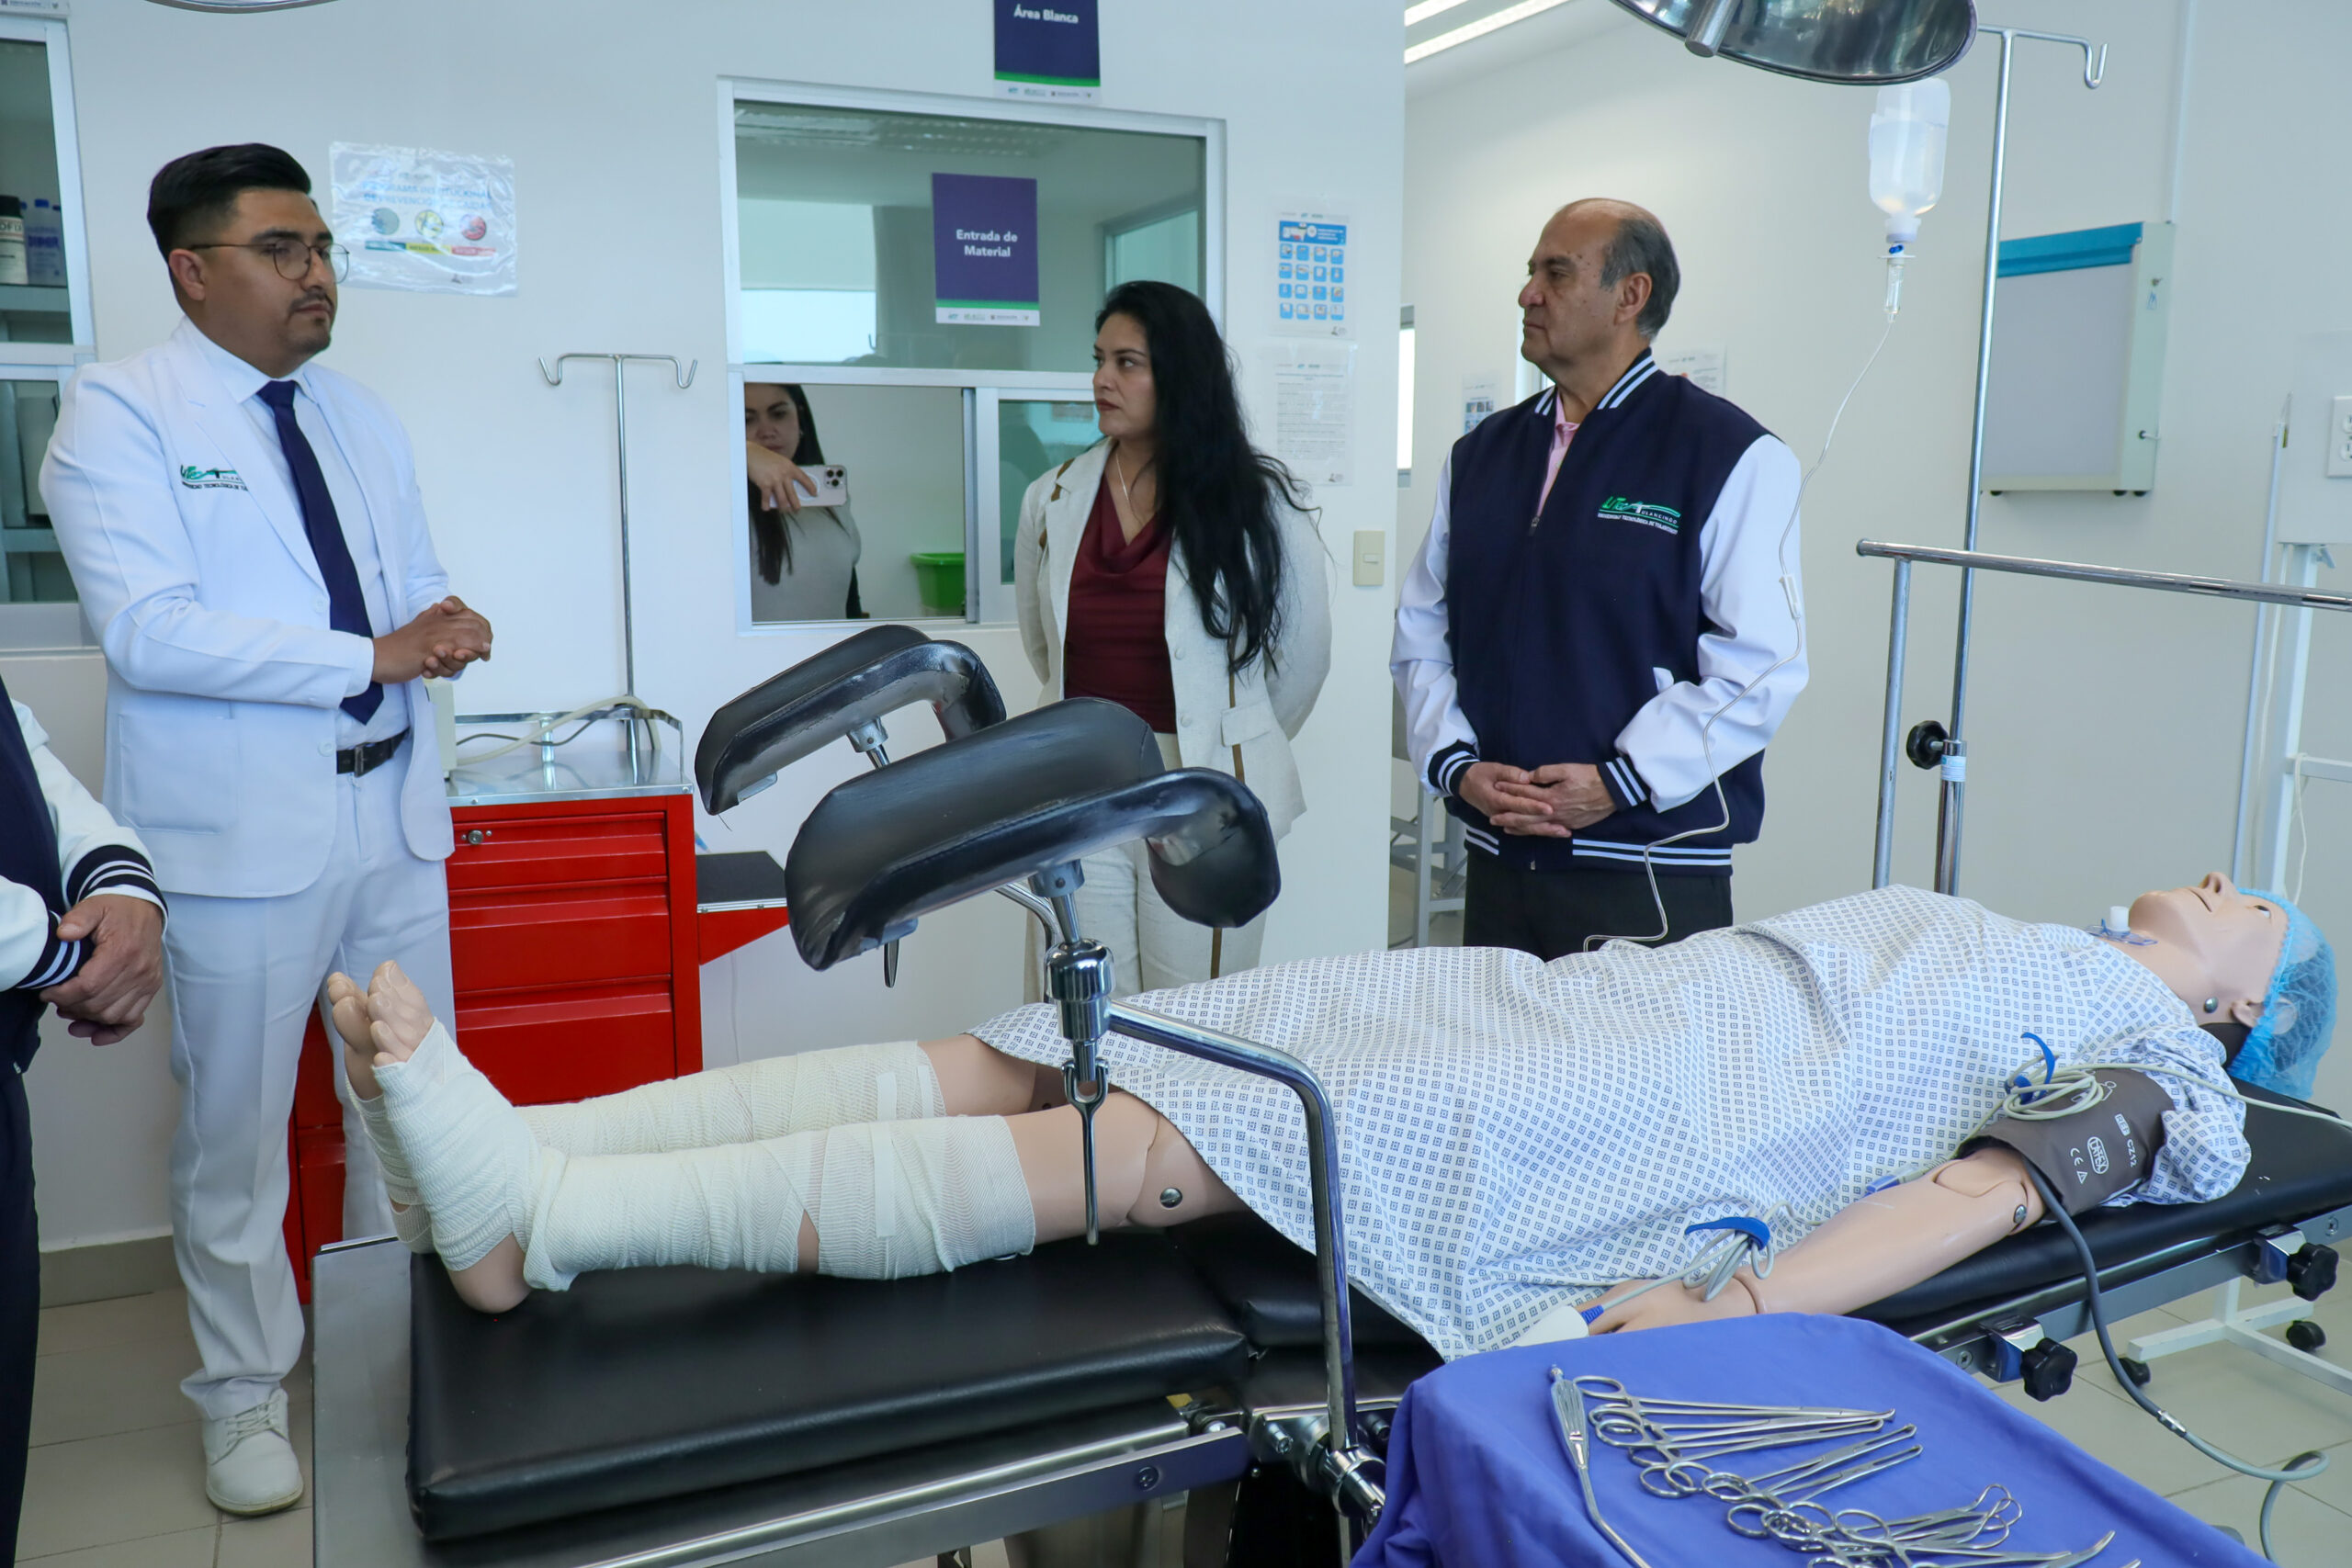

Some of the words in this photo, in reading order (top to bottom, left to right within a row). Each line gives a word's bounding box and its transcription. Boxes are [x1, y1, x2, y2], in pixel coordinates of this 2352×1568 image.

[1013, 4, 1041, 20] Área
[1043, 9, 1079, 24] Blanca
[956, 229, 1001, 242] Entrada
[1003, 231, 1018, 243] de
[964, 244, 1012, 257] Material
[2127, 1138, 2137, 1168] CZ12
